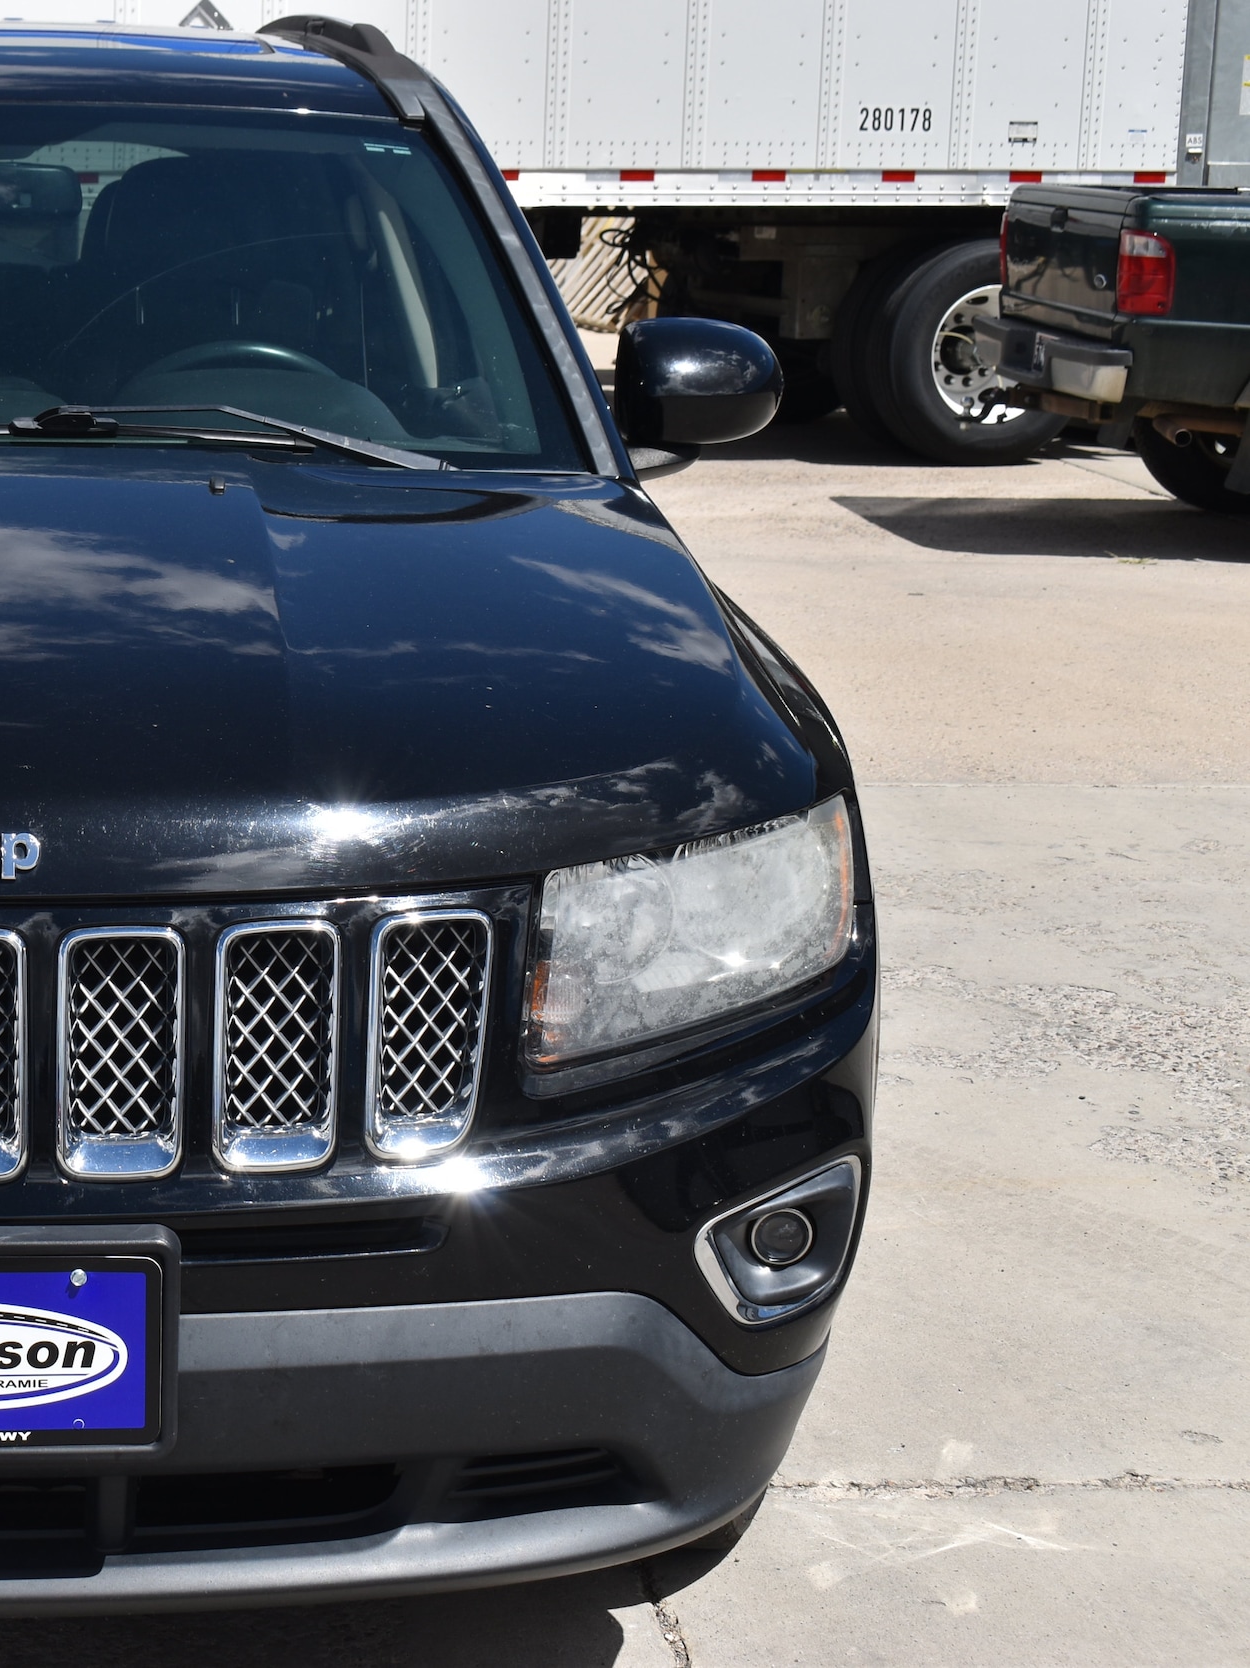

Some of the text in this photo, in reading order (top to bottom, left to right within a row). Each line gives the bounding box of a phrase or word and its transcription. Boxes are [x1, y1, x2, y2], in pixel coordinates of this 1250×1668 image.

[859, 107, 932, 132] 280178
[1187, 137, 1202, 145] ABS
[0, 1431, 32, 1442] WY
